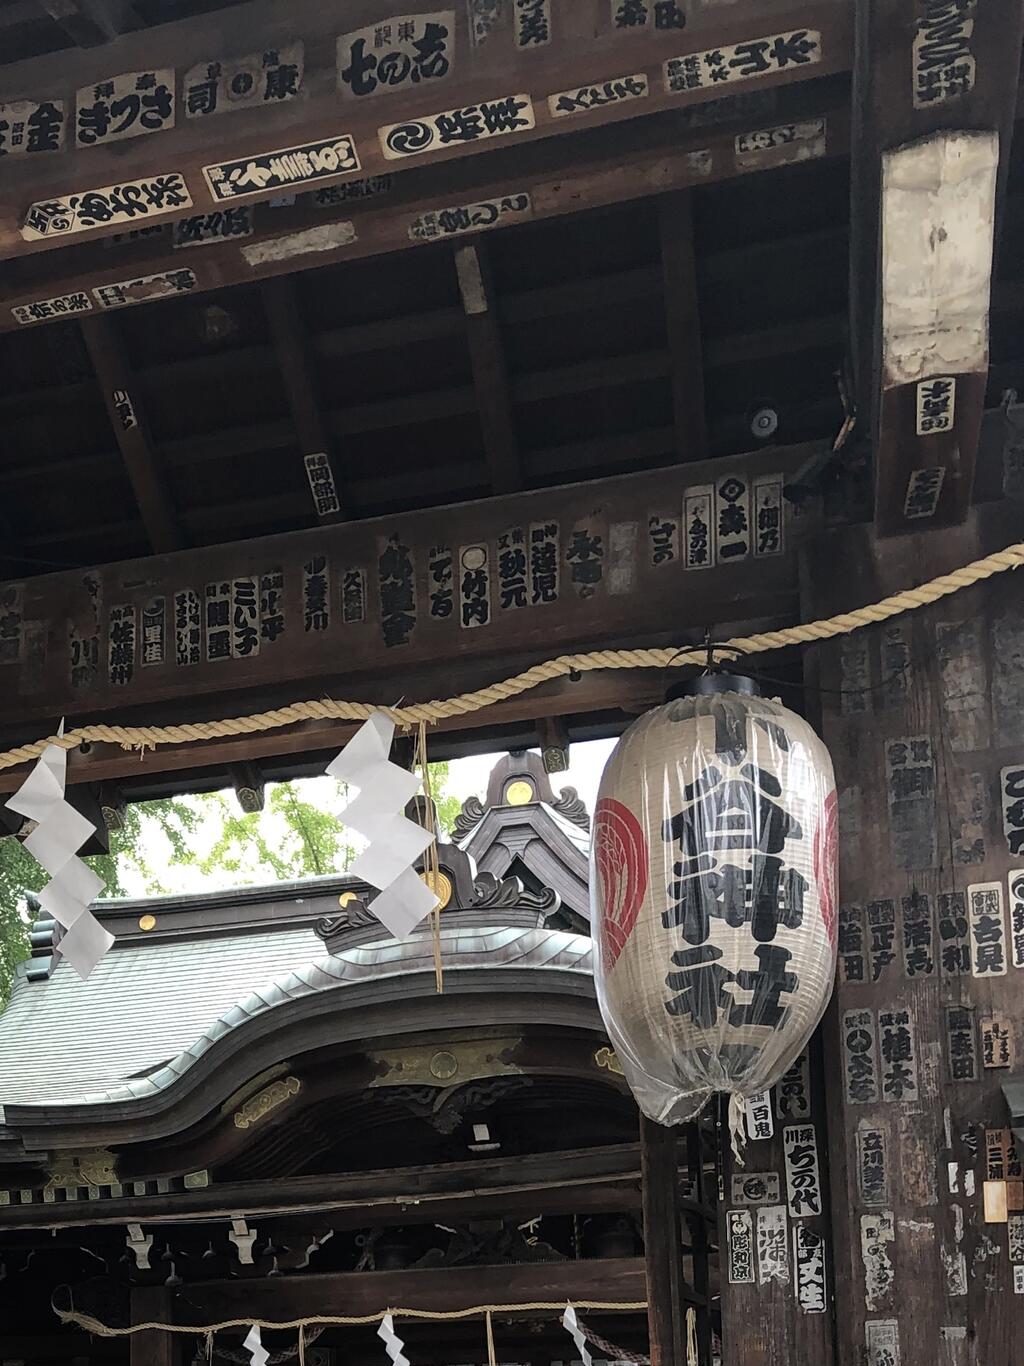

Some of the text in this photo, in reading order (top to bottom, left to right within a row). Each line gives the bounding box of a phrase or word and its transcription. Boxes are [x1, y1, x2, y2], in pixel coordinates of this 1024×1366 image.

[729, 31, 820, 77] 山本
[660, 703, 809, 1034] 下谷神社
[752, 1105, 772, 1138] 百鬼
